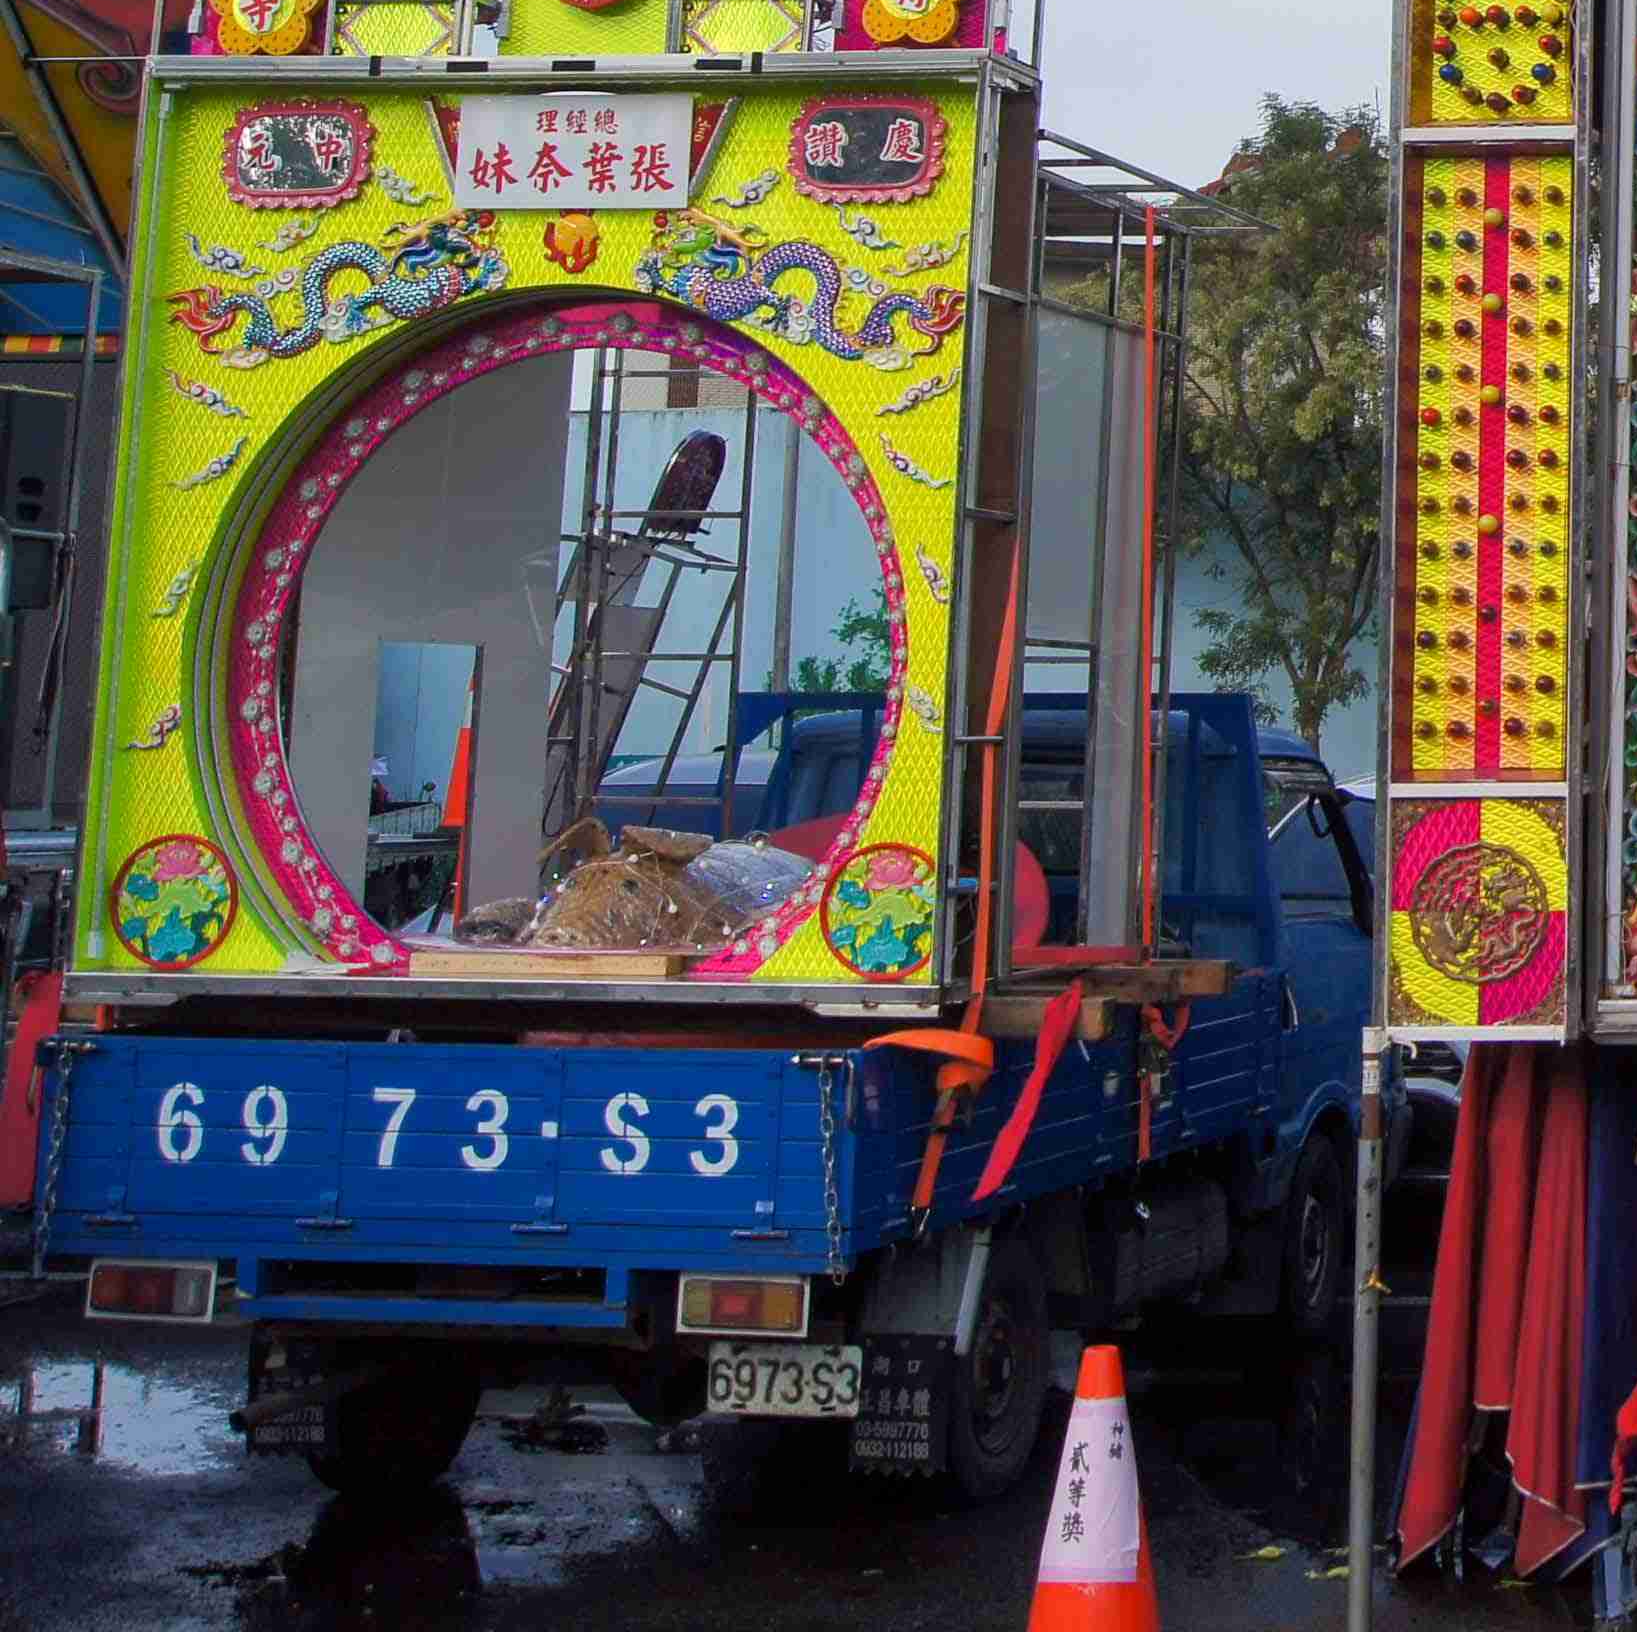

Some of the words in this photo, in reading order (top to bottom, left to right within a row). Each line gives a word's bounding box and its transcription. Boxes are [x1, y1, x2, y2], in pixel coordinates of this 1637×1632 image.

[536, 108, 619, 136] 總經理
[805, 118, 925, 166] 慶讚
[240, 128, 346, 171] 中元
[469, 142, 675, 194] 張葉奈妹
